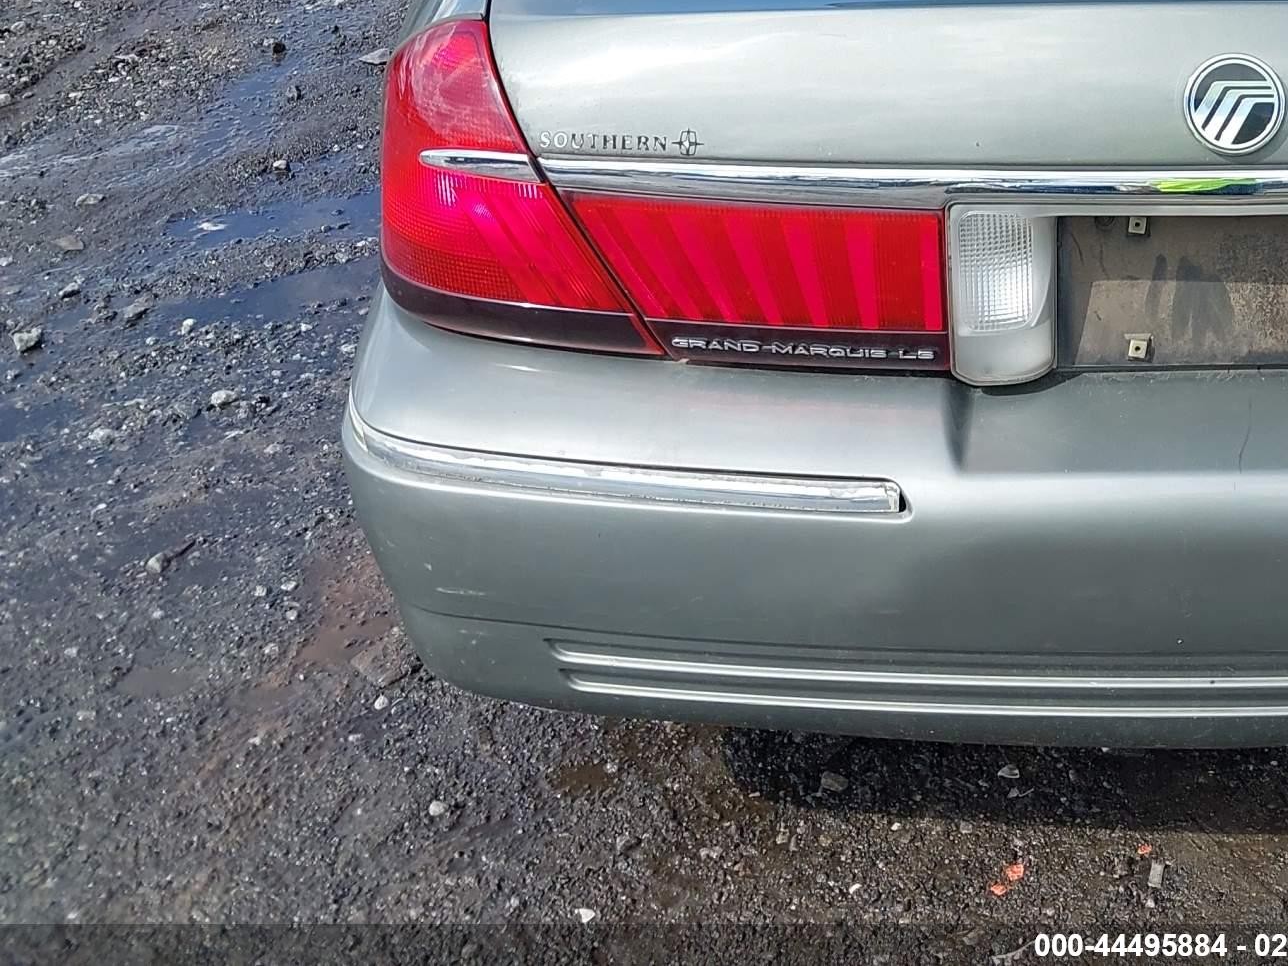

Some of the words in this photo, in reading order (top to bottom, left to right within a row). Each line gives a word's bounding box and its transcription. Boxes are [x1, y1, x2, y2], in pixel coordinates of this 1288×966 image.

[540, 131, 668, 151] SOUTHERN
[671, 337, 761, 352] GRAND
[771, 341, 888, 359] MARQUIS
[899, 347, 935, 360] LS
